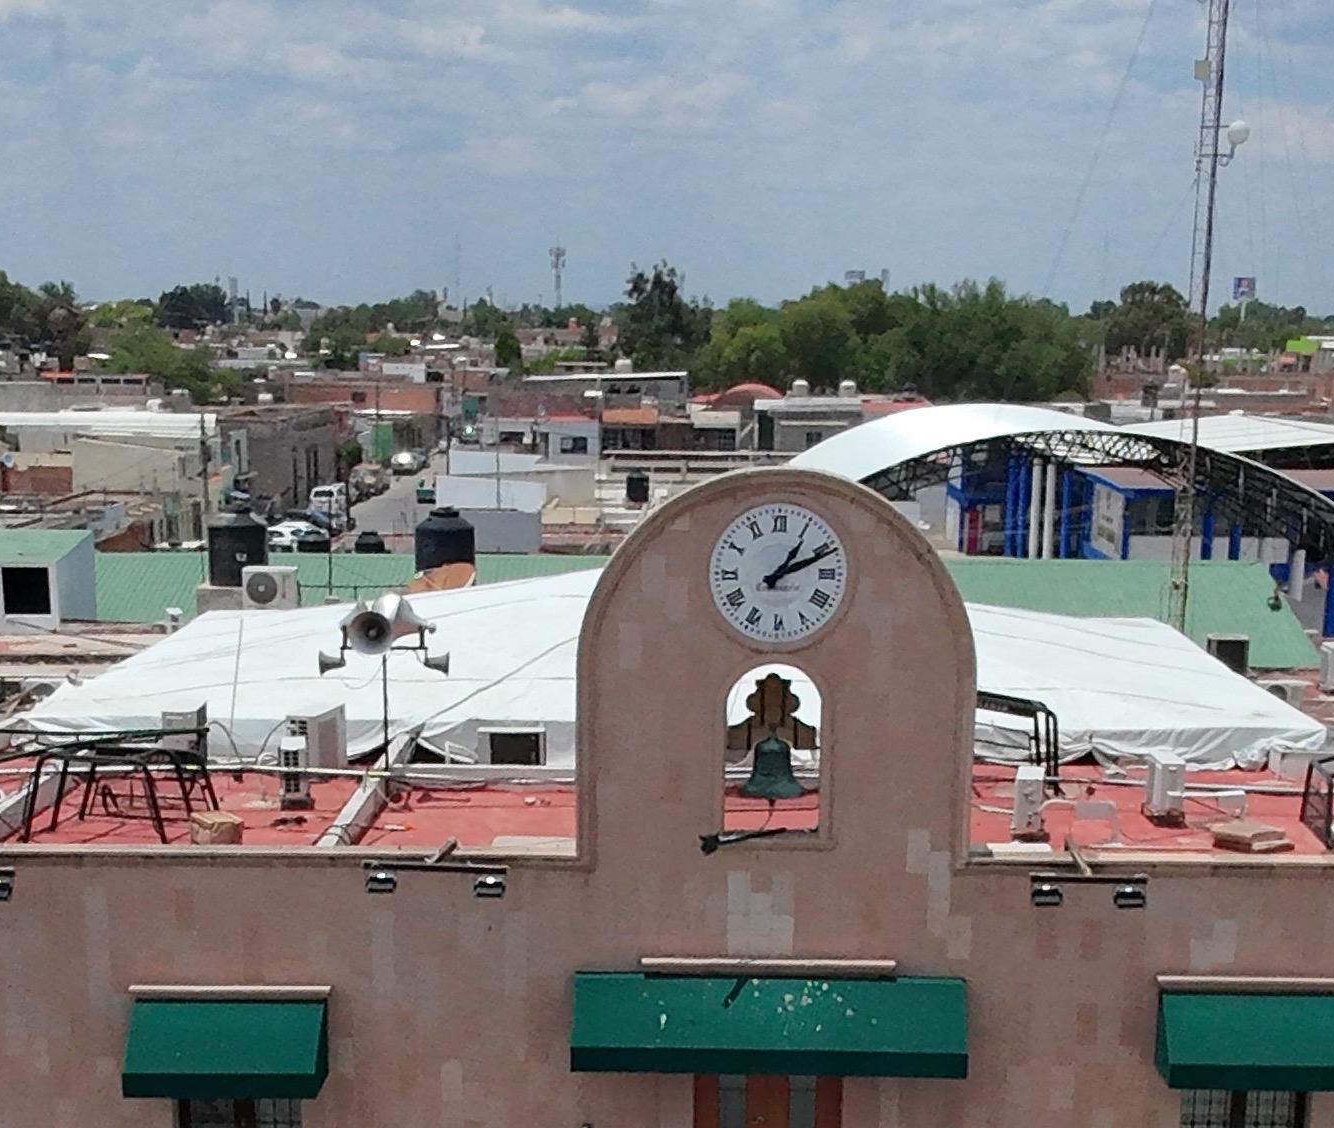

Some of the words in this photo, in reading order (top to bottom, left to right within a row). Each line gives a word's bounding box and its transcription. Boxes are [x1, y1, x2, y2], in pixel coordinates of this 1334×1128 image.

[747, 521, 763, 540] XI
[772, 515, 787, 533] XII
[729, 542, 746, 556] X
[818, 568, 836, 580] III
[798, 611, 810, 625] V
